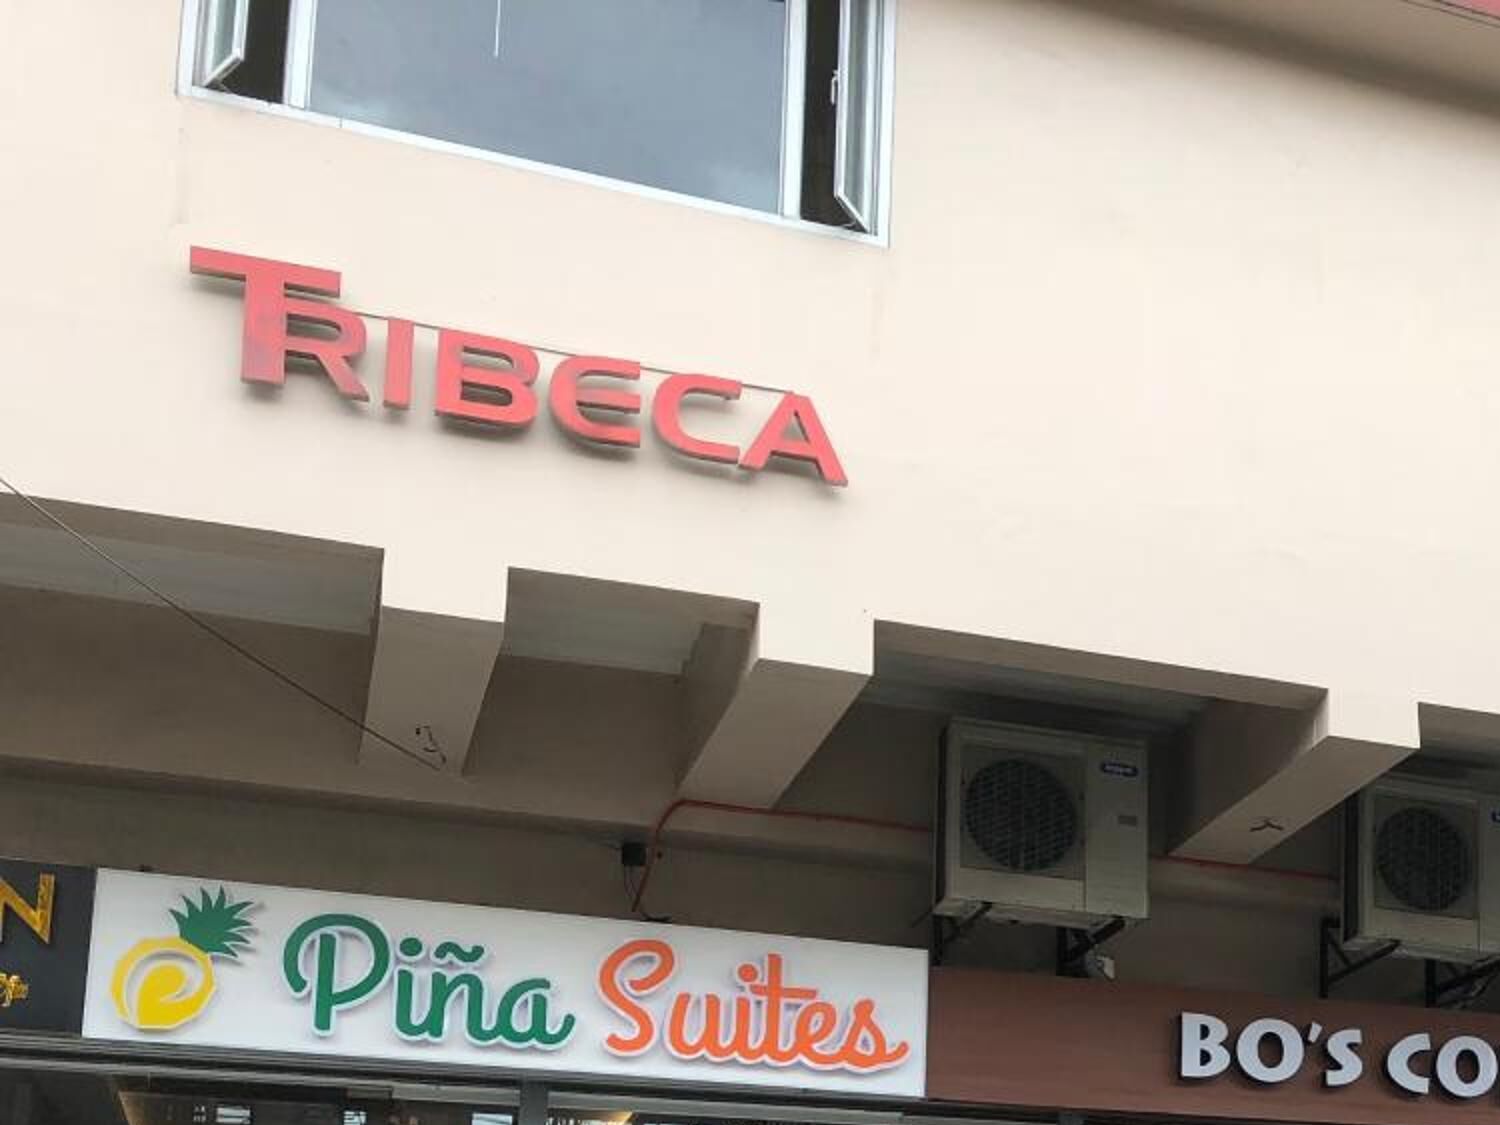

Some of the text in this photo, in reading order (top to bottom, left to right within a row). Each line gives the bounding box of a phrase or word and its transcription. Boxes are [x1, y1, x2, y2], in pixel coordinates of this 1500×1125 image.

[190, 245, 849, 487] TRIBECA
[283, 912, 910, 1070] Piña Suites
[1181, 1011, 1364, 1087] BO'S
